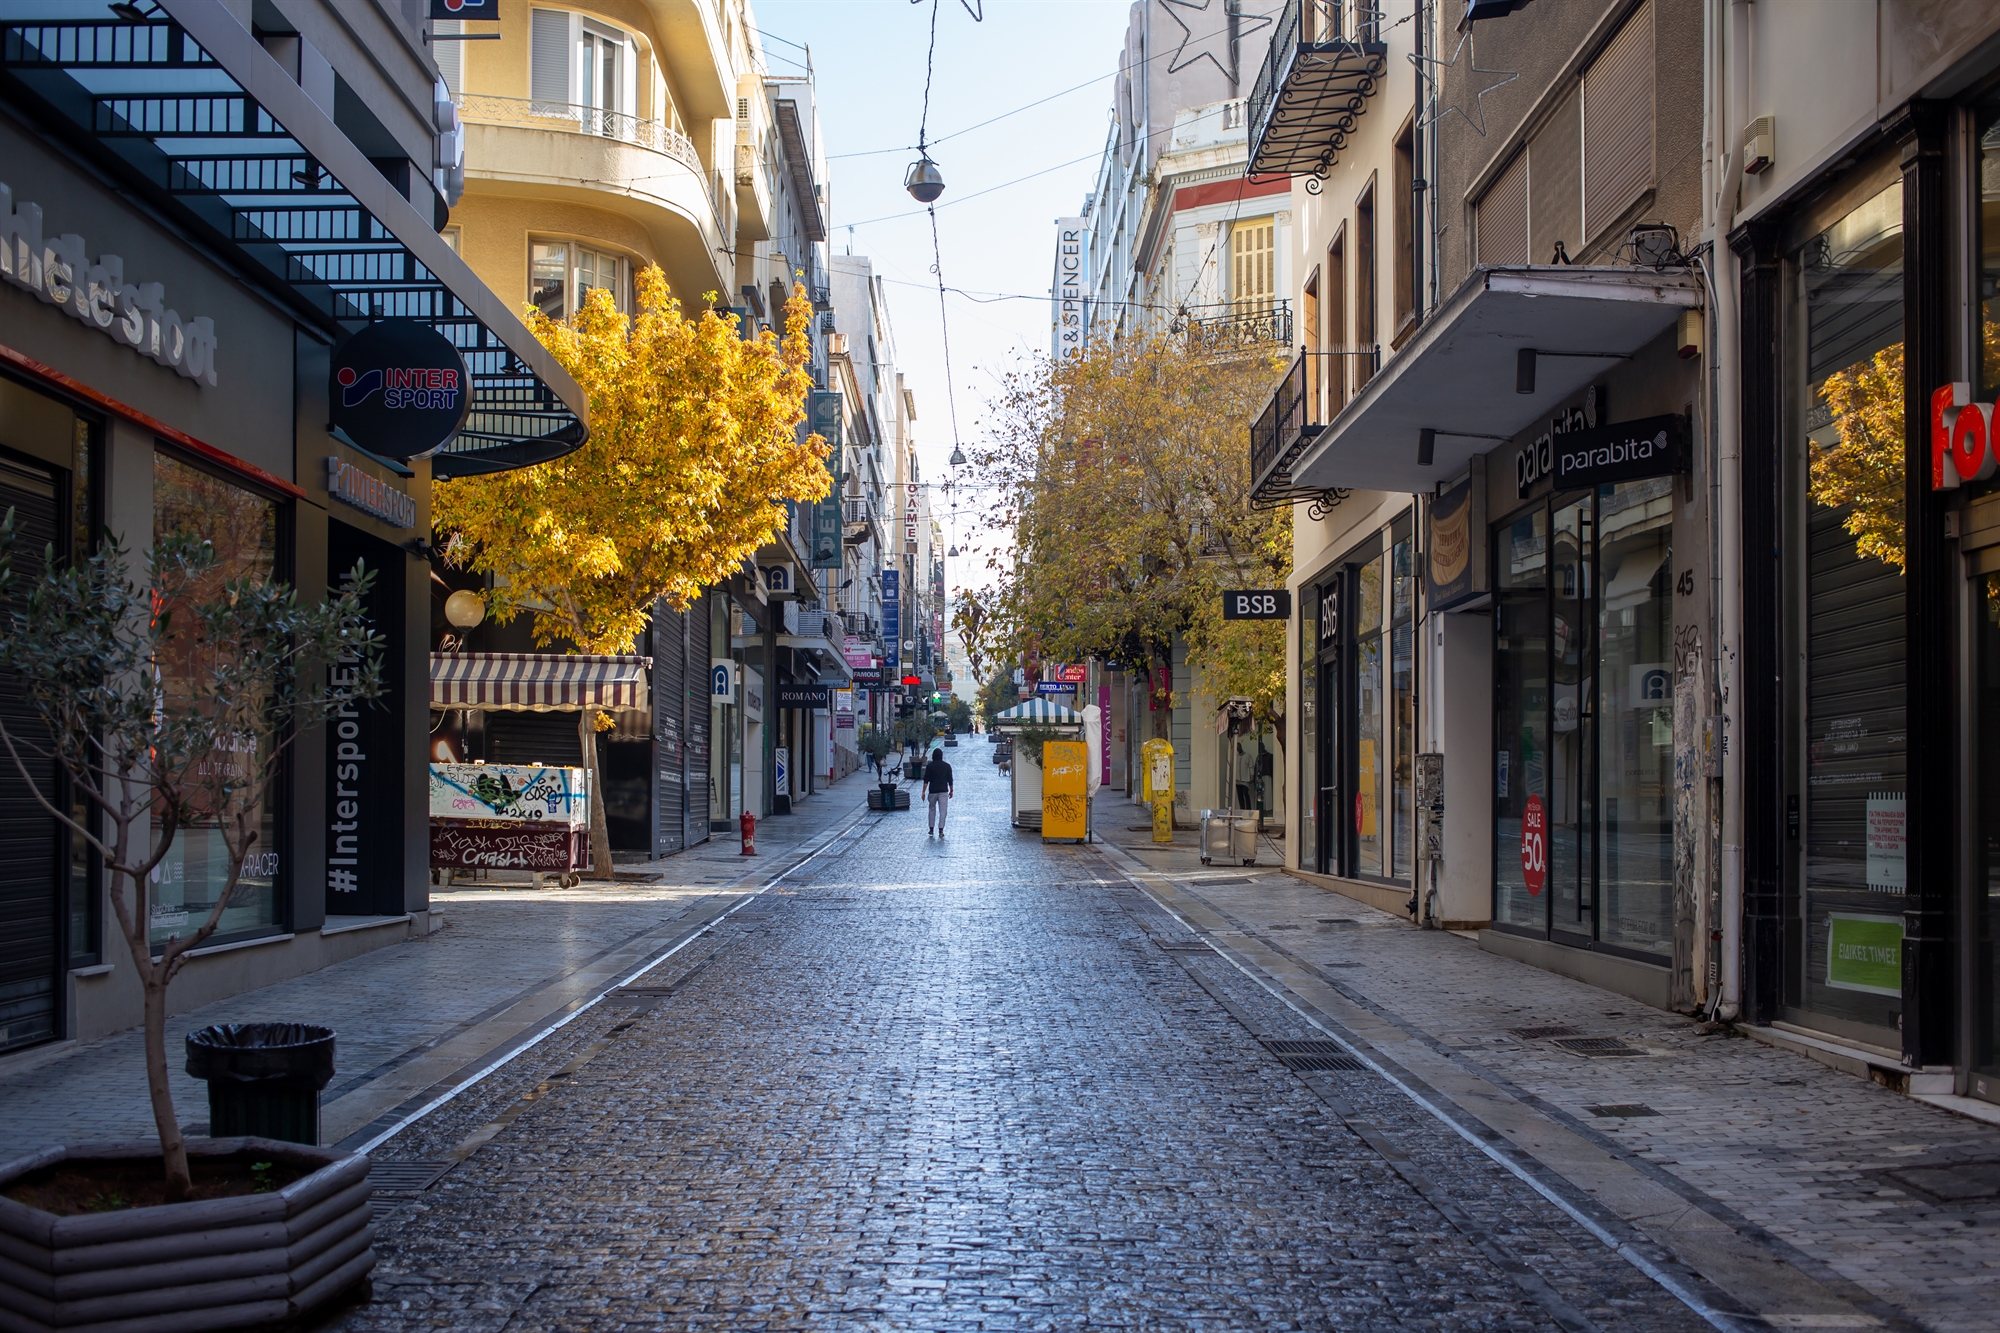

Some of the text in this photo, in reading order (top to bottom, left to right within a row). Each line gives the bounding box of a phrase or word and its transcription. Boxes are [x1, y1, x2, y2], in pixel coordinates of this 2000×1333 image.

[1063, 230, 1079, 325] SPENCER
[385, 367, 459, 388] INTER
[384, 388, 459, 409] SPORT
[1561, 438, 1653, 475] parabita
[350, 464, 416, 528] INTERSPORT
[1676, 569, 1694, 597] 45
[1237, 595, 1277, 614] BSB
[1322, 593, 1338, 640] BSB
[781, 692, 826, 701] ROMANO
[1527, 812, 1541, 828] SALE
[1839, 943, 1896, 964] ΕΙΔΙΚΕΣ ΤΙΜΕΣ
